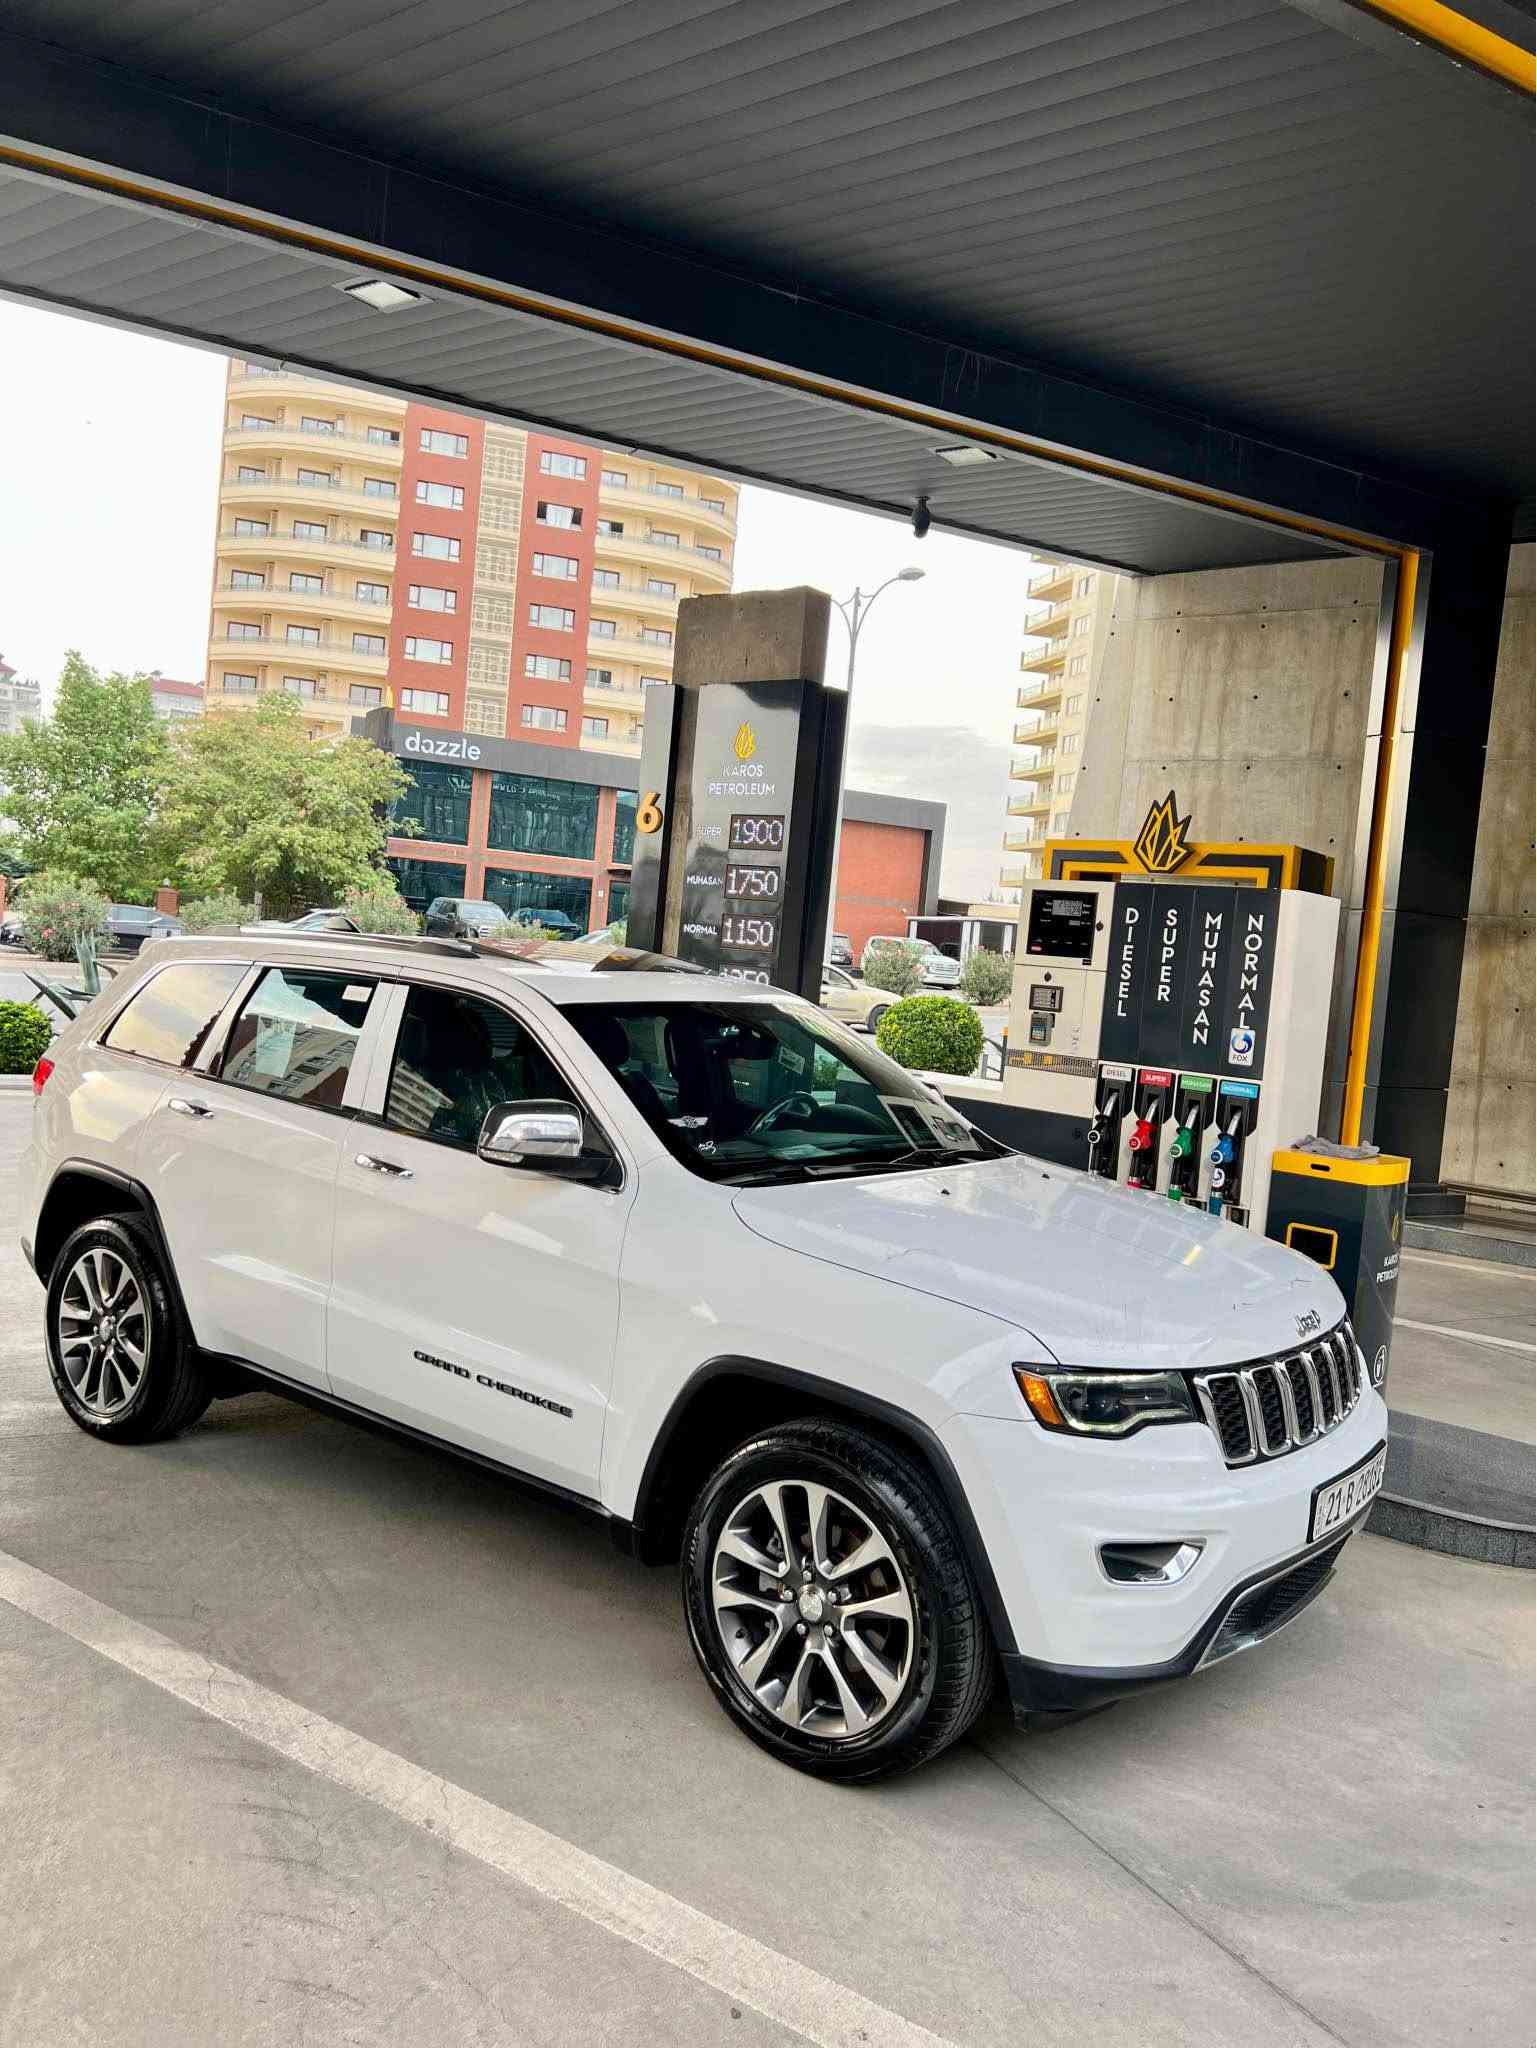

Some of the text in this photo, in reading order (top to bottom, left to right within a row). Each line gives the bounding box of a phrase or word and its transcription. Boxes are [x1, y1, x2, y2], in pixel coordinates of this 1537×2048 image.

[405, 731, 481, 761] dazzle
[708, 782, 776, 796] PETROLEUM
[636, 791, 664, 834] 6
[733, 819, 784, 845] 1900
[727, 868, 779, 896] 1750
[683, 918, 774, 947] NORMAL 1150
[1117, 907, 1140, 1017] DIESEL
[1157, 908, 1178, 1002] SUPER
[1238, 913, 1265, 1029] NORMAL
[1192, 911, 1223, 1046] MUHASAN
[1232, 1054, 1248, 1062] FOX
[413, 1349, 574, 1418] GRAND CHEROKEE
[1325, 1486, 1343, 1526] 21
